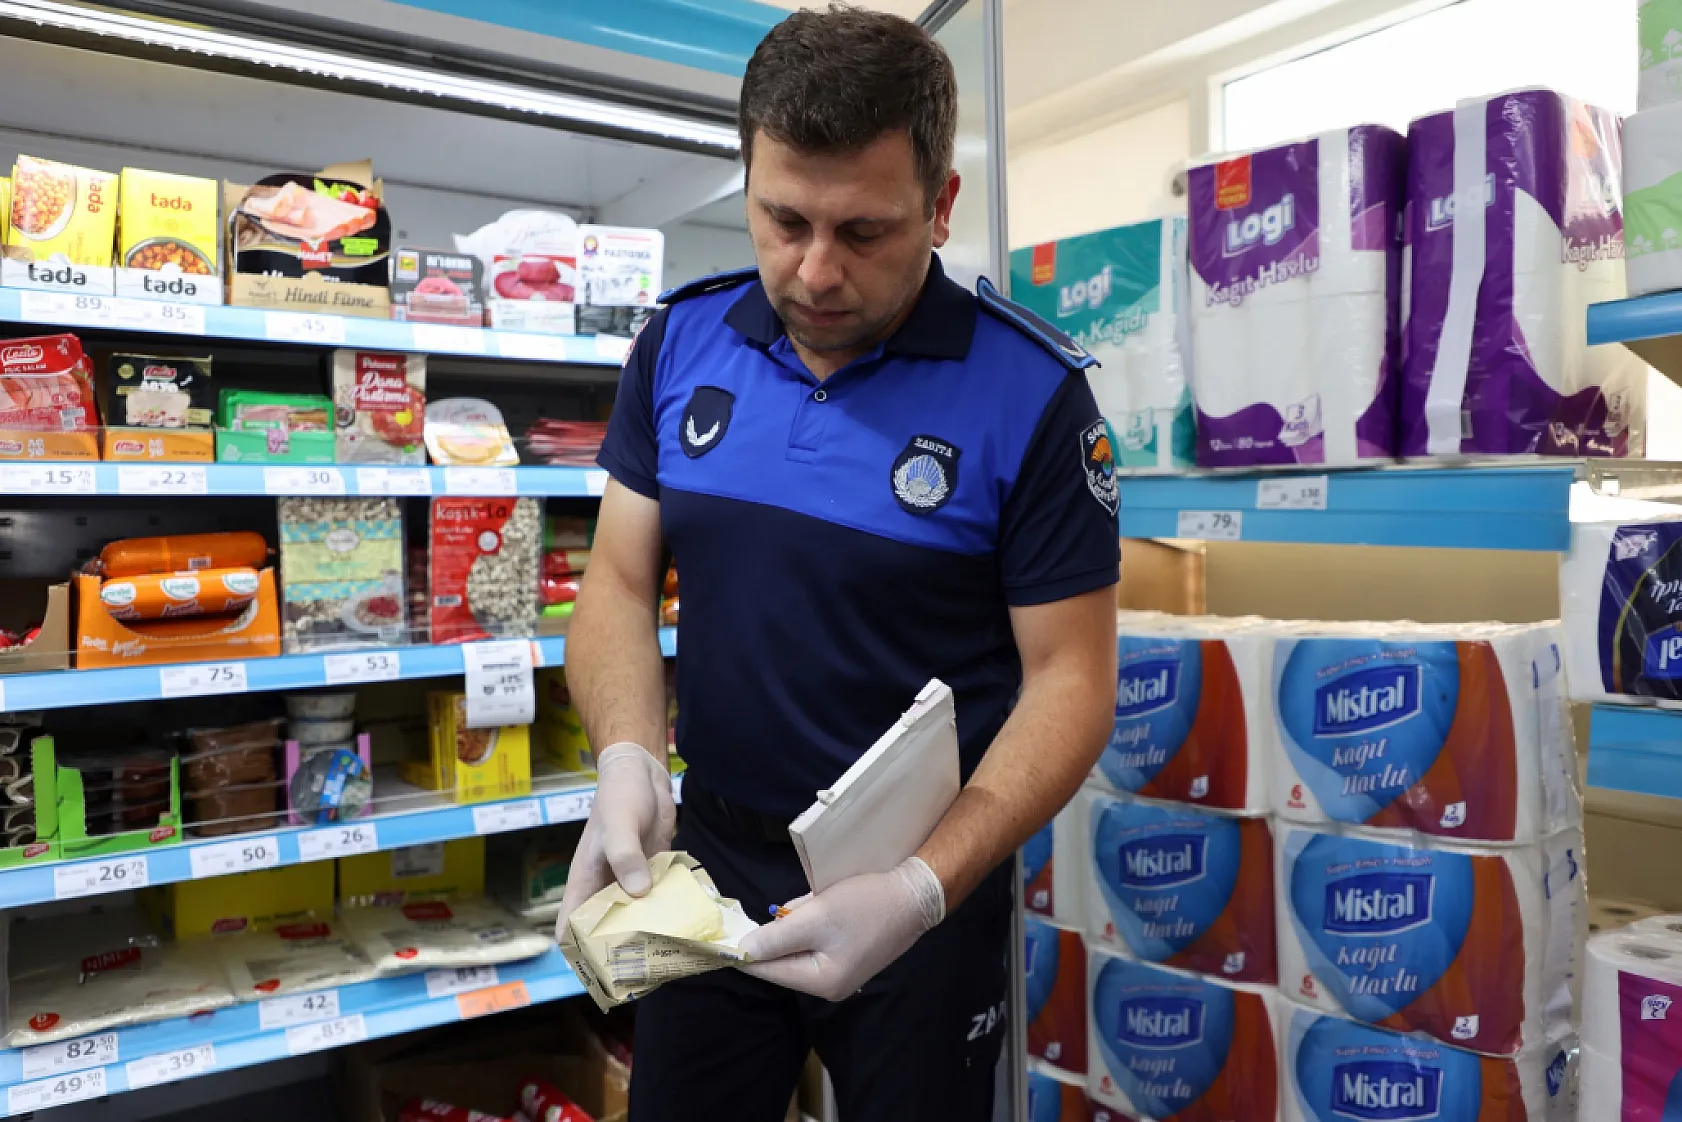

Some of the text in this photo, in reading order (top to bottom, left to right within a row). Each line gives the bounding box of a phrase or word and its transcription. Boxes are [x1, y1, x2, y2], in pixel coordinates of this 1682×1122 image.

[88, 177, 104, 214] tada
[151, 192, 193, 213] tada
[1227, 193, 1294, 251] Logi
[28, 263, 86, 286] tada
[143, 274, 197, 297] tada
[1060, 265, 1113, 310] Logi
[284, 286, 328, 304] Hindi
[207, 666, 234, 682] 75
[1118, 668, 1169, 708] istral
[1326, 674, 1405, 724] Mistral
[243, 844, 267, 863] 50
[341, 828, 364, 846] 26
[1125, 842, 1192, 878] Mistral
[1333, 883, 1416, 923] Mistral
[1125, 1006, 1191, 1038] Mistral
[1342, 1072, 1424, 1110] Mistral
